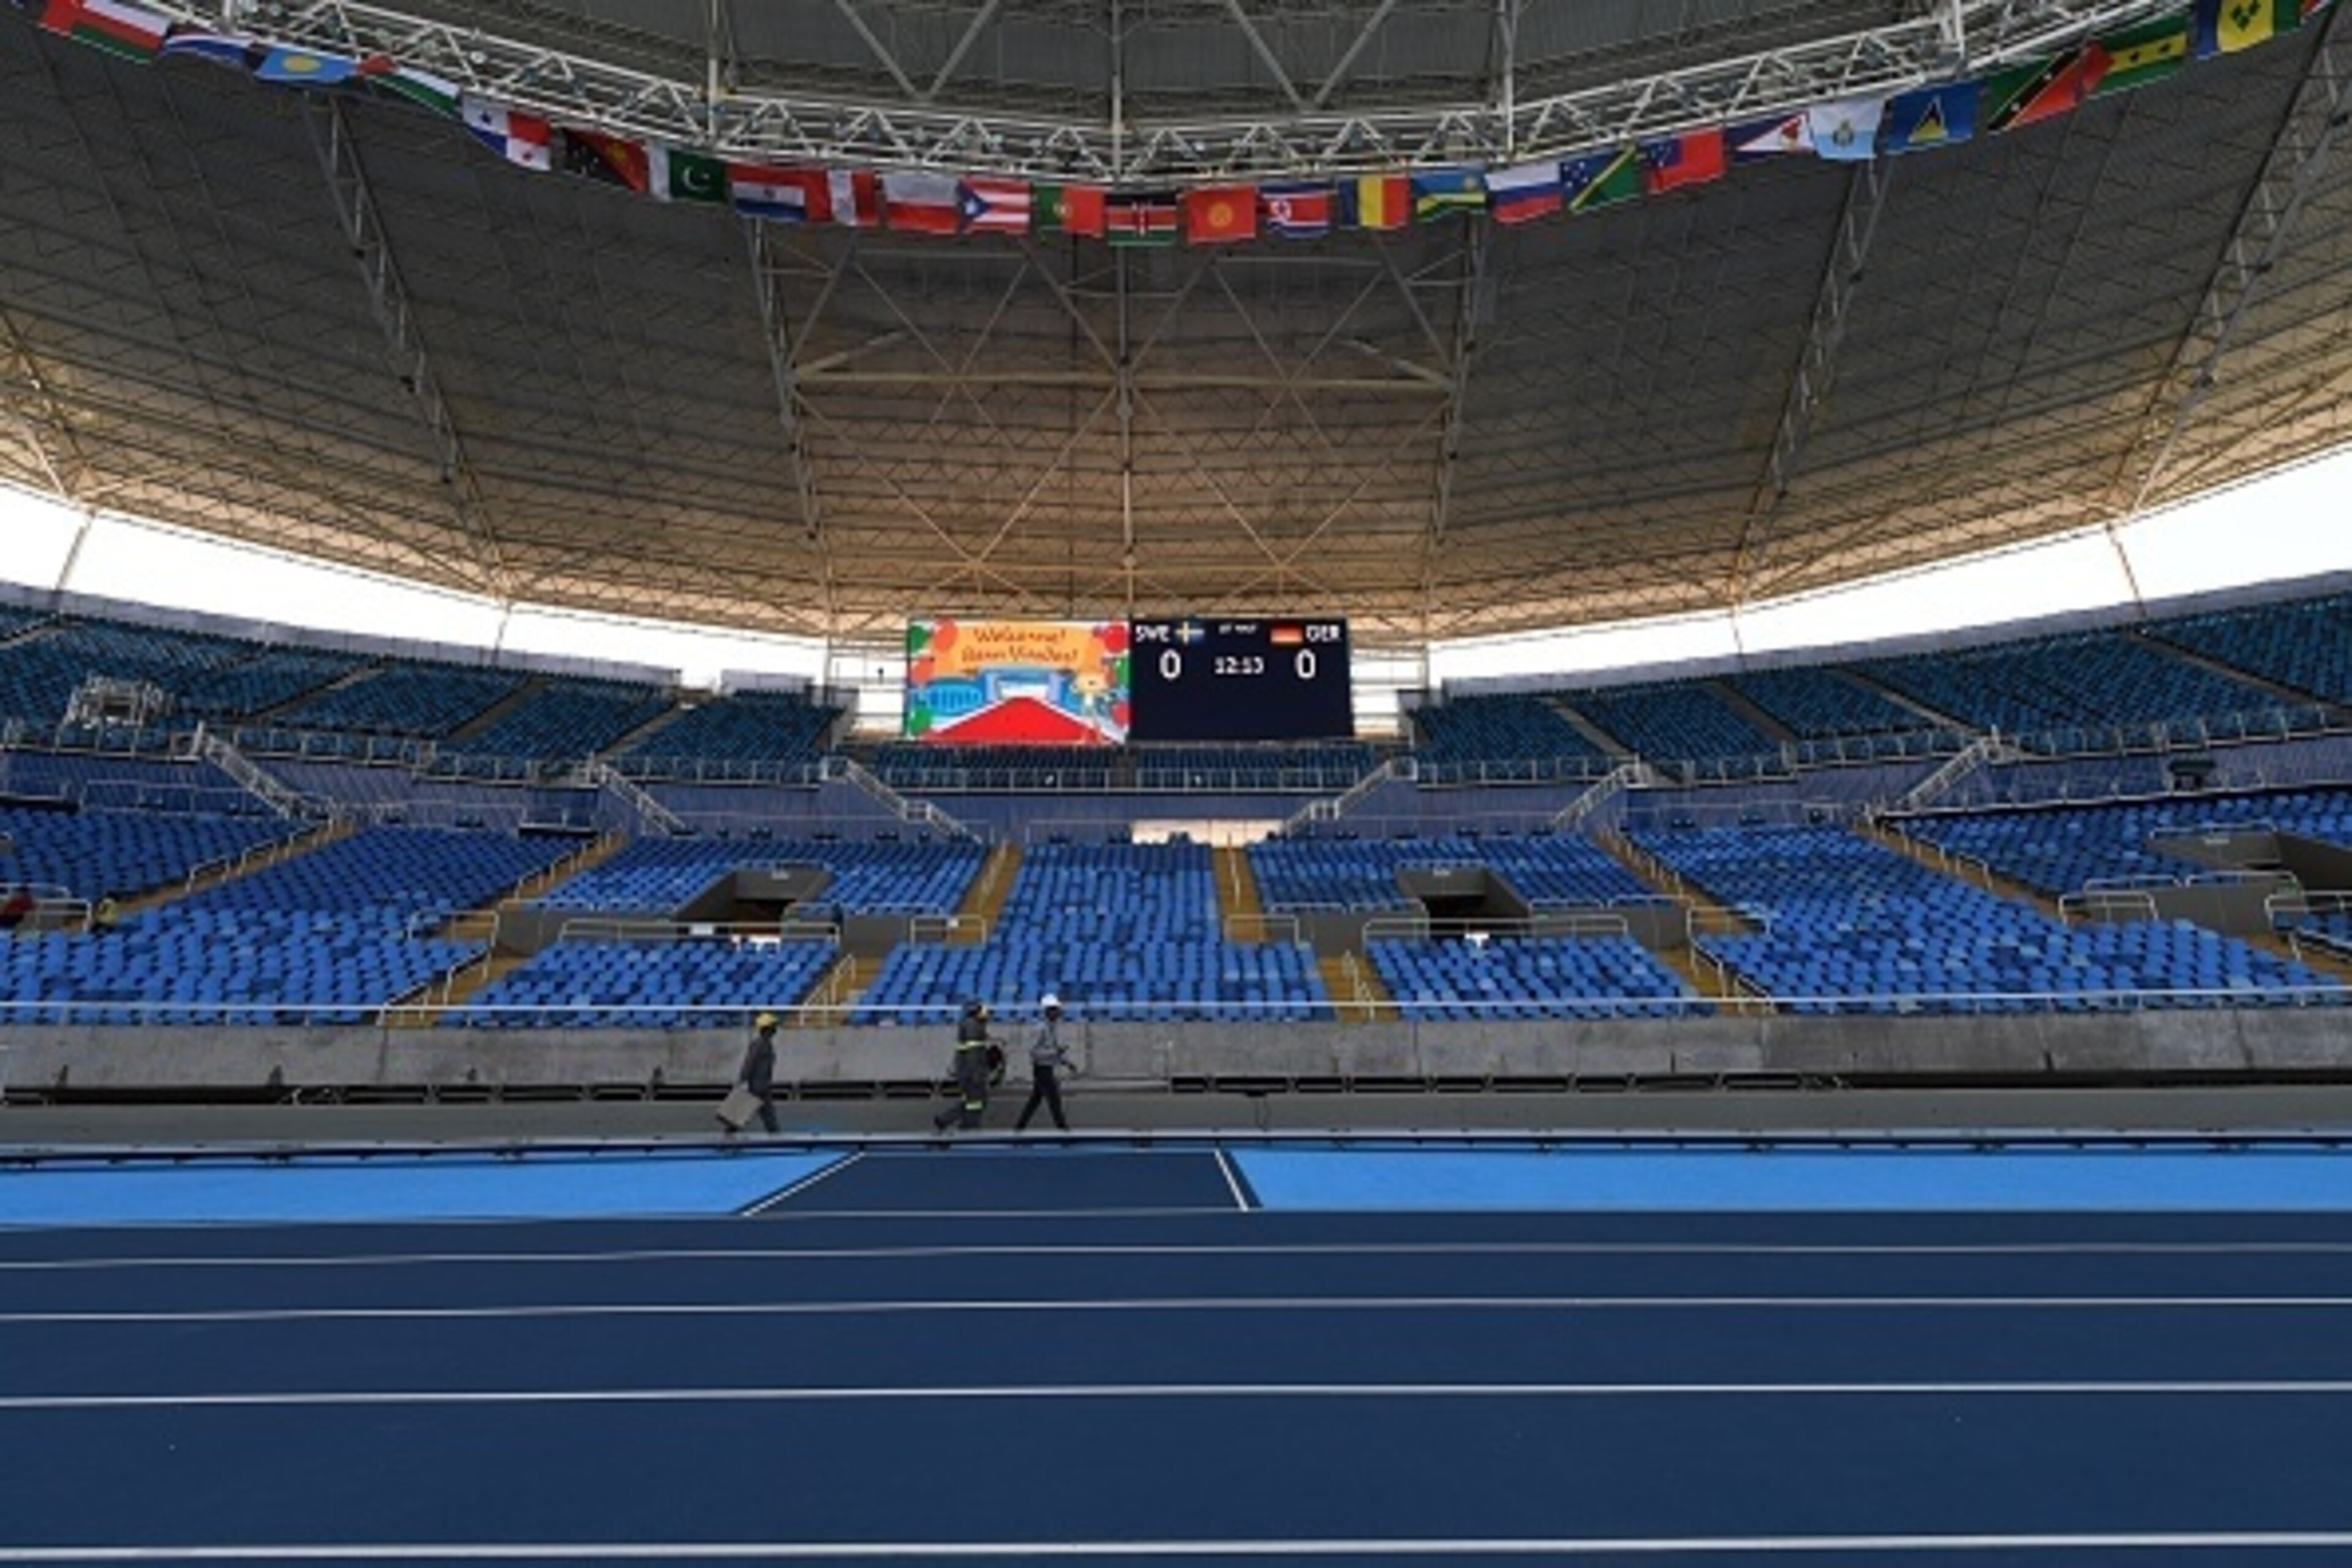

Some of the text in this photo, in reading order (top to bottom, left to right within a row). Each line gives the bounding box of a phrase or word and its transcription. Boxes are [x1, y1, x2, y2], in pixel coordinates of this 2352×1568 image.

[973, 625, 1066, 643] Welcome!
[1135, 625, 1170, 642] SWE
[1305, 624, 1341, 642] GER
[1160, 649, 1181, 679] 0
[1295, 649, 1316, 679] 0
